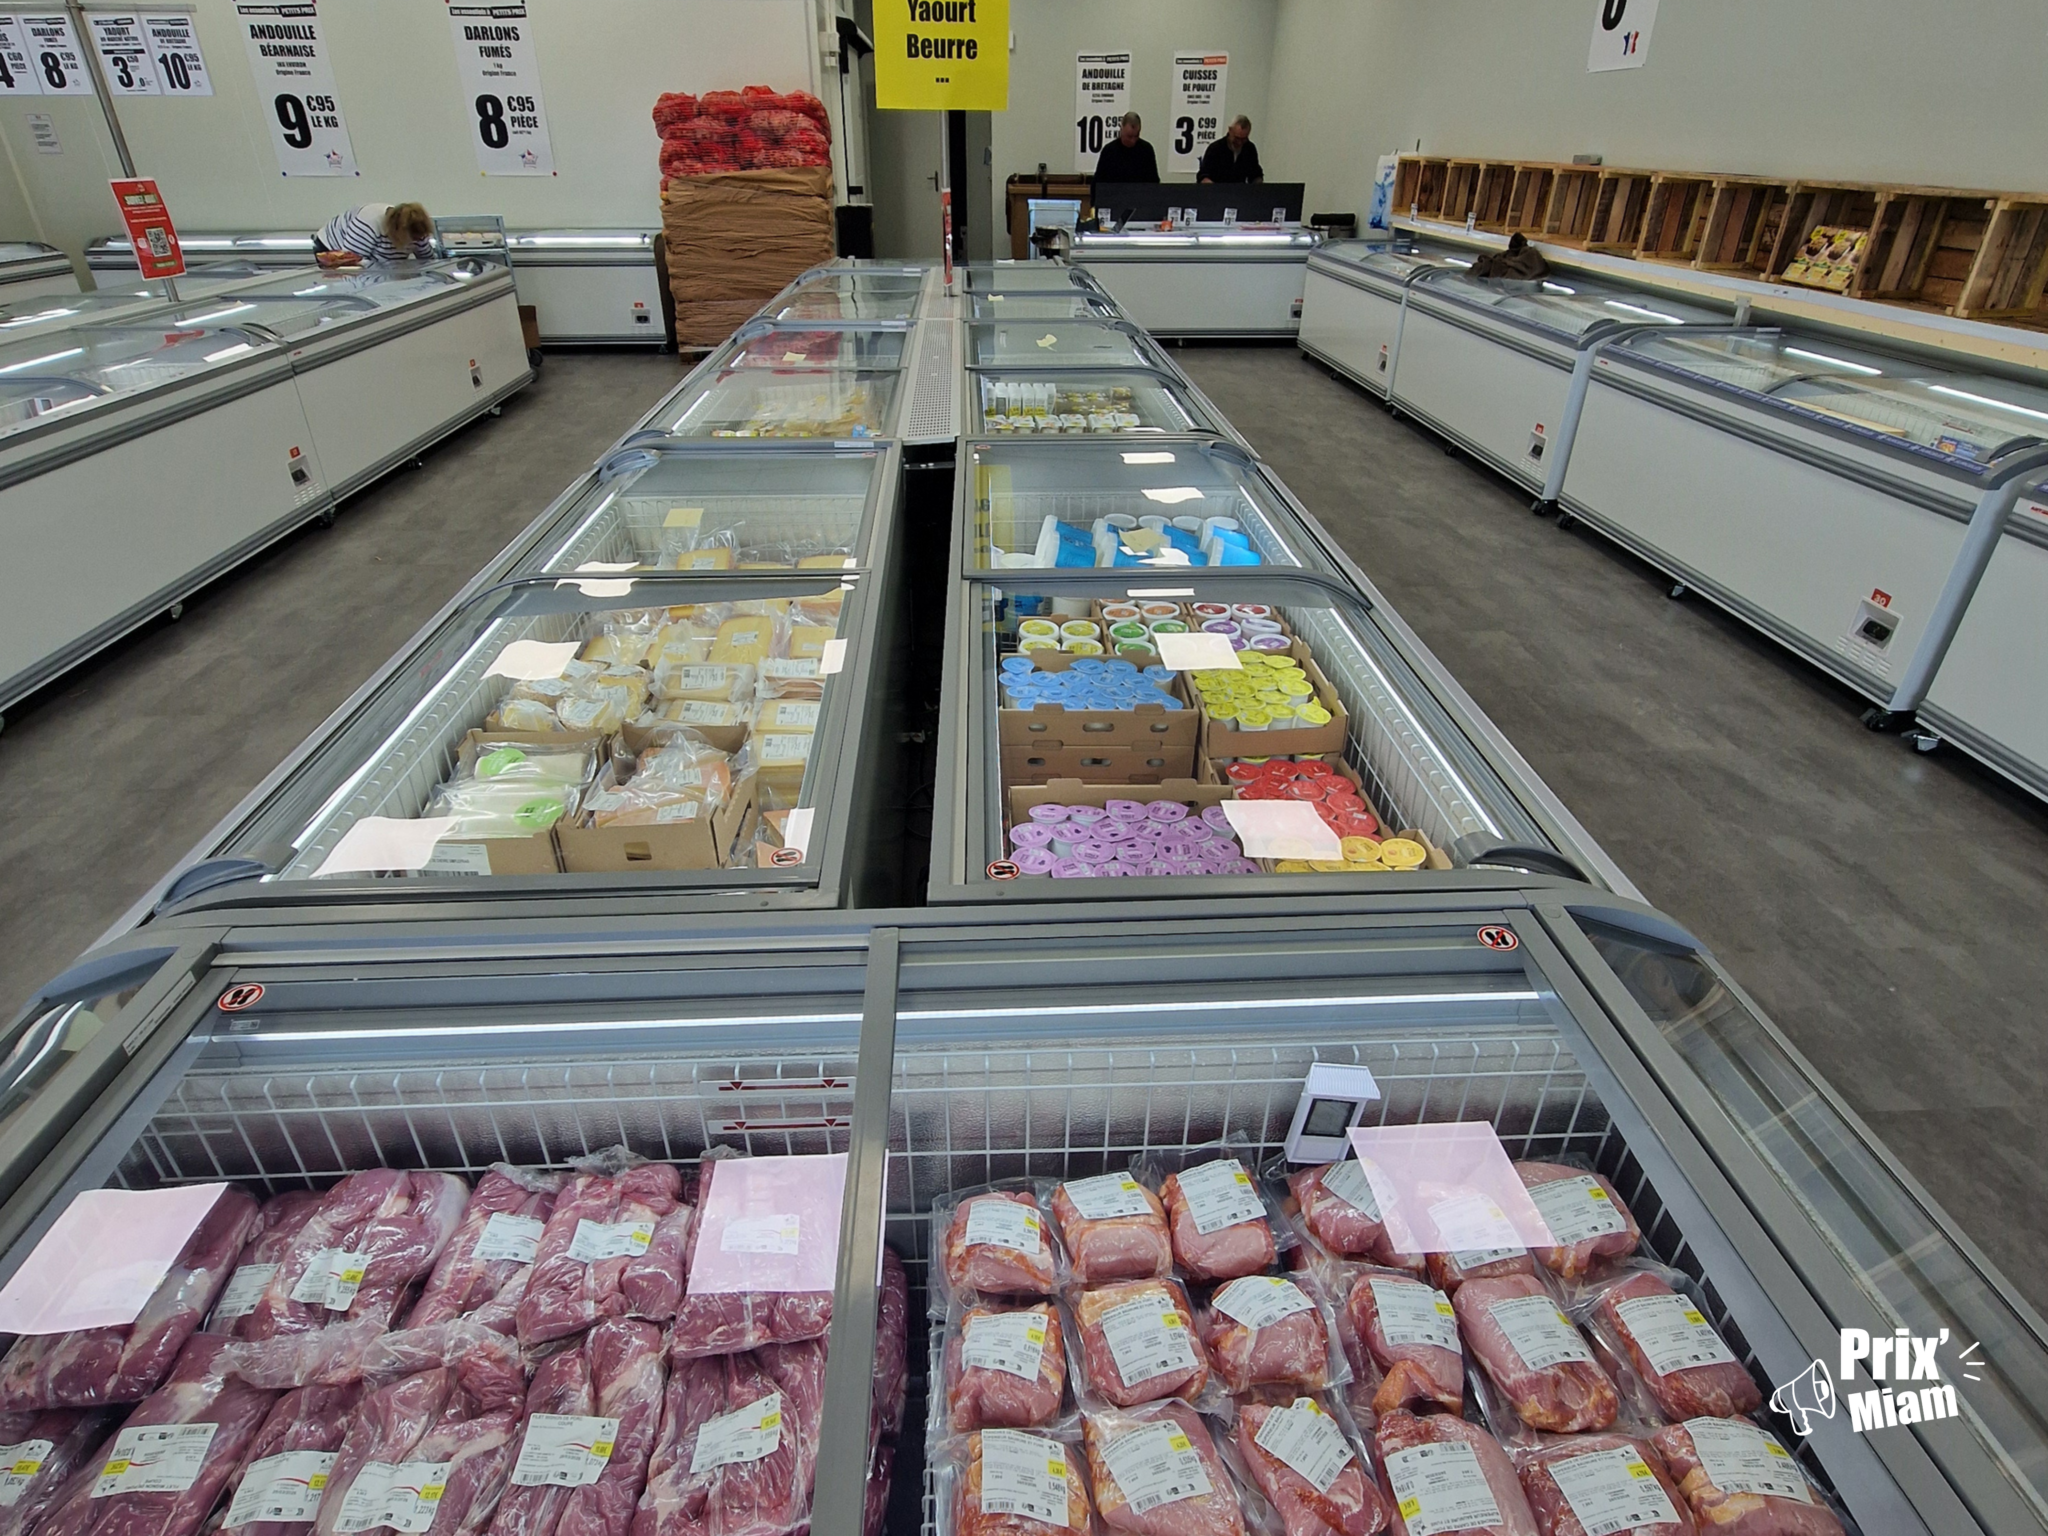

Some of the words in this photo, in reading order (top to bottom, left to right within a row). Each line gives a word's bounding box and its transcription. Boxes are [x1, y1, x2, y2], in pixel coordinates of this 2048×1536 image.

[907, 0, 976, 23] Yaourt
[152, 28, 190, 38] ANDOUILLE
[249, 24, 317, 40] ANDOUILLE
[464, 26, 520, 41] DARLONS
[259, 42, 316, 57] BÉARNAISE
[479, 44, 512, 58] FUMÉS
[907, 33, 978, 60] Beurre
[40, 51, 67, 89] 8
[112, 56, 134, 88] 3
[158, 52, 192, 90] 10
[1082, 68, 1125, 79] ANDOUILLE
[1183, 69, 1218, 81] CUISSES
[1082, 82, 1090, 91] DE
[1091, 82, 1125, 91] BRETAGNE
[1183, 83, 1191, 92] DE
[1192, 83, 1216, 92] POULET
[275, 93, 313, 149] 9
[311, 115, 323, 128] LE
[323, 115, 339, 128] KG
[475, 93, 509, 149] 8
[510, 113, 539, 128] PIÈCE
[1077, 115, 1103, 153] 10
[1175, 116, 1195, 155] 3
